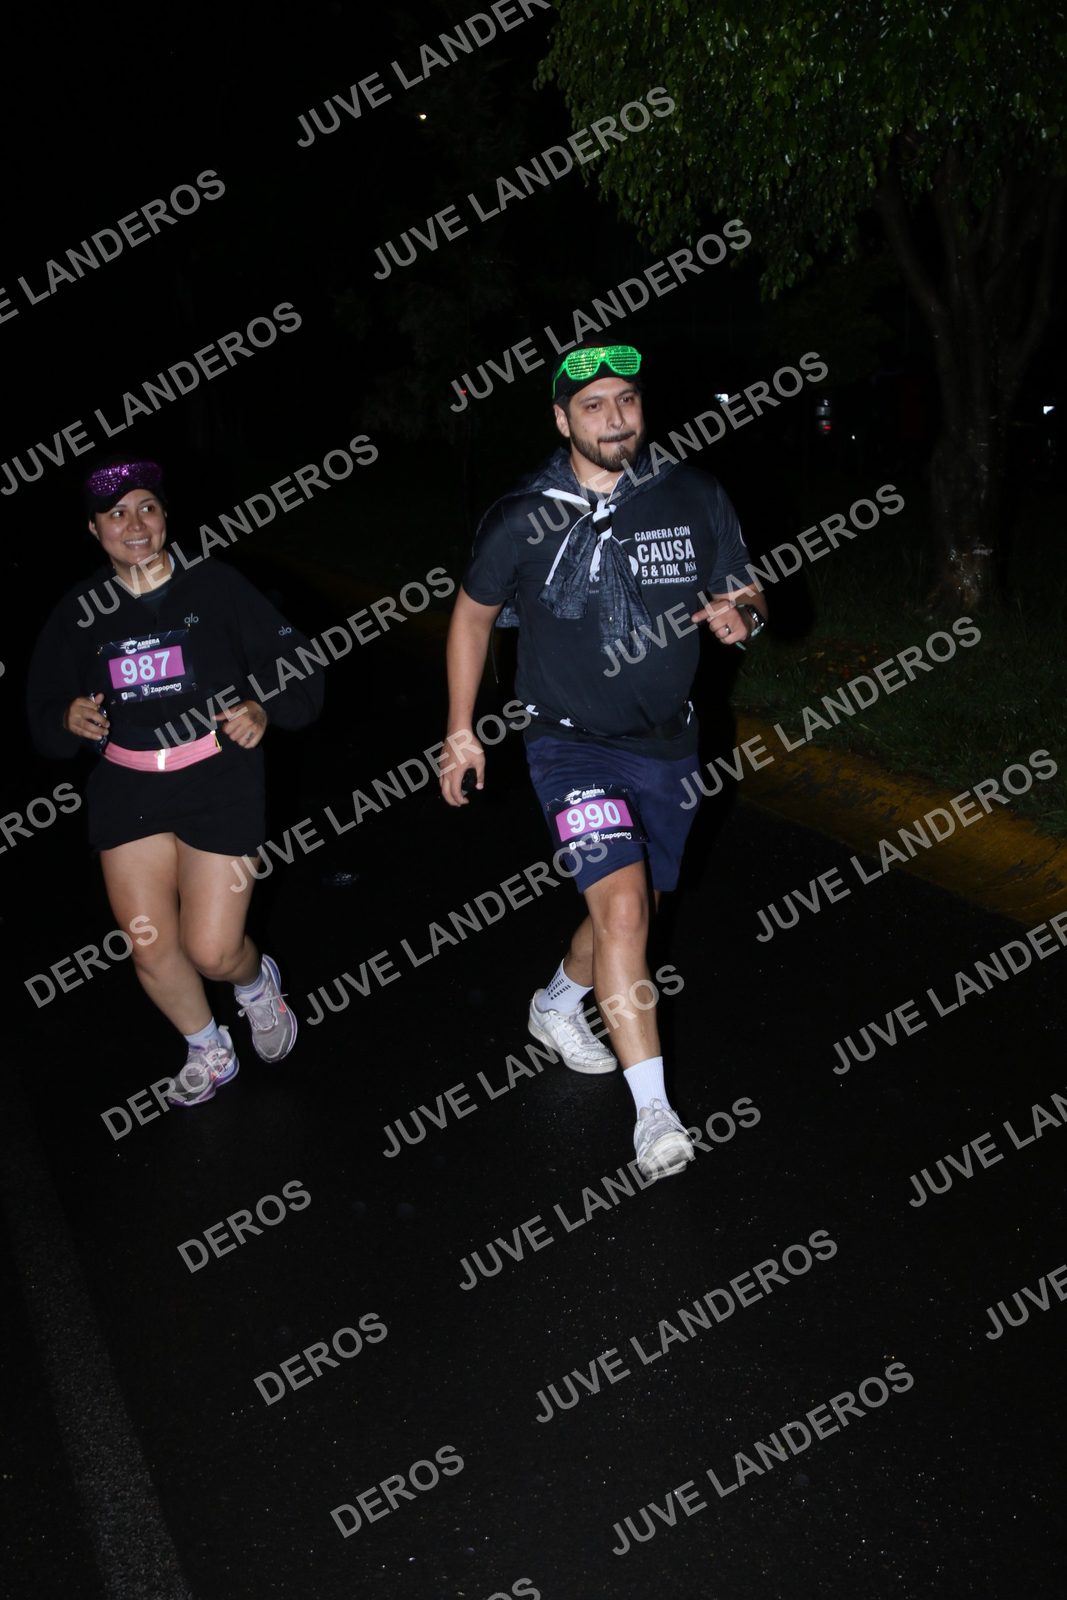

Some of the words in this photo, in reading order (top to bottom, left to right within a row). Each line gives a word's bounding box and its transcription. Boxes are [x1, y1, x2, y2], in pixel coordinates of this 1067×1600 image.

[634, 530, 673, 542] CARRERA
[674, 526, 691, 537] CON
[637, 538, 695, 563] CAUSA
[642, 565, 648, 577] 5
[650, 565, 658, 577] &
[660, 564, 680, 576] 10K
[184, 613, 199, 624] alo
[120, 650, 170, 684] 987
[566, 801, 621, 833] 990
